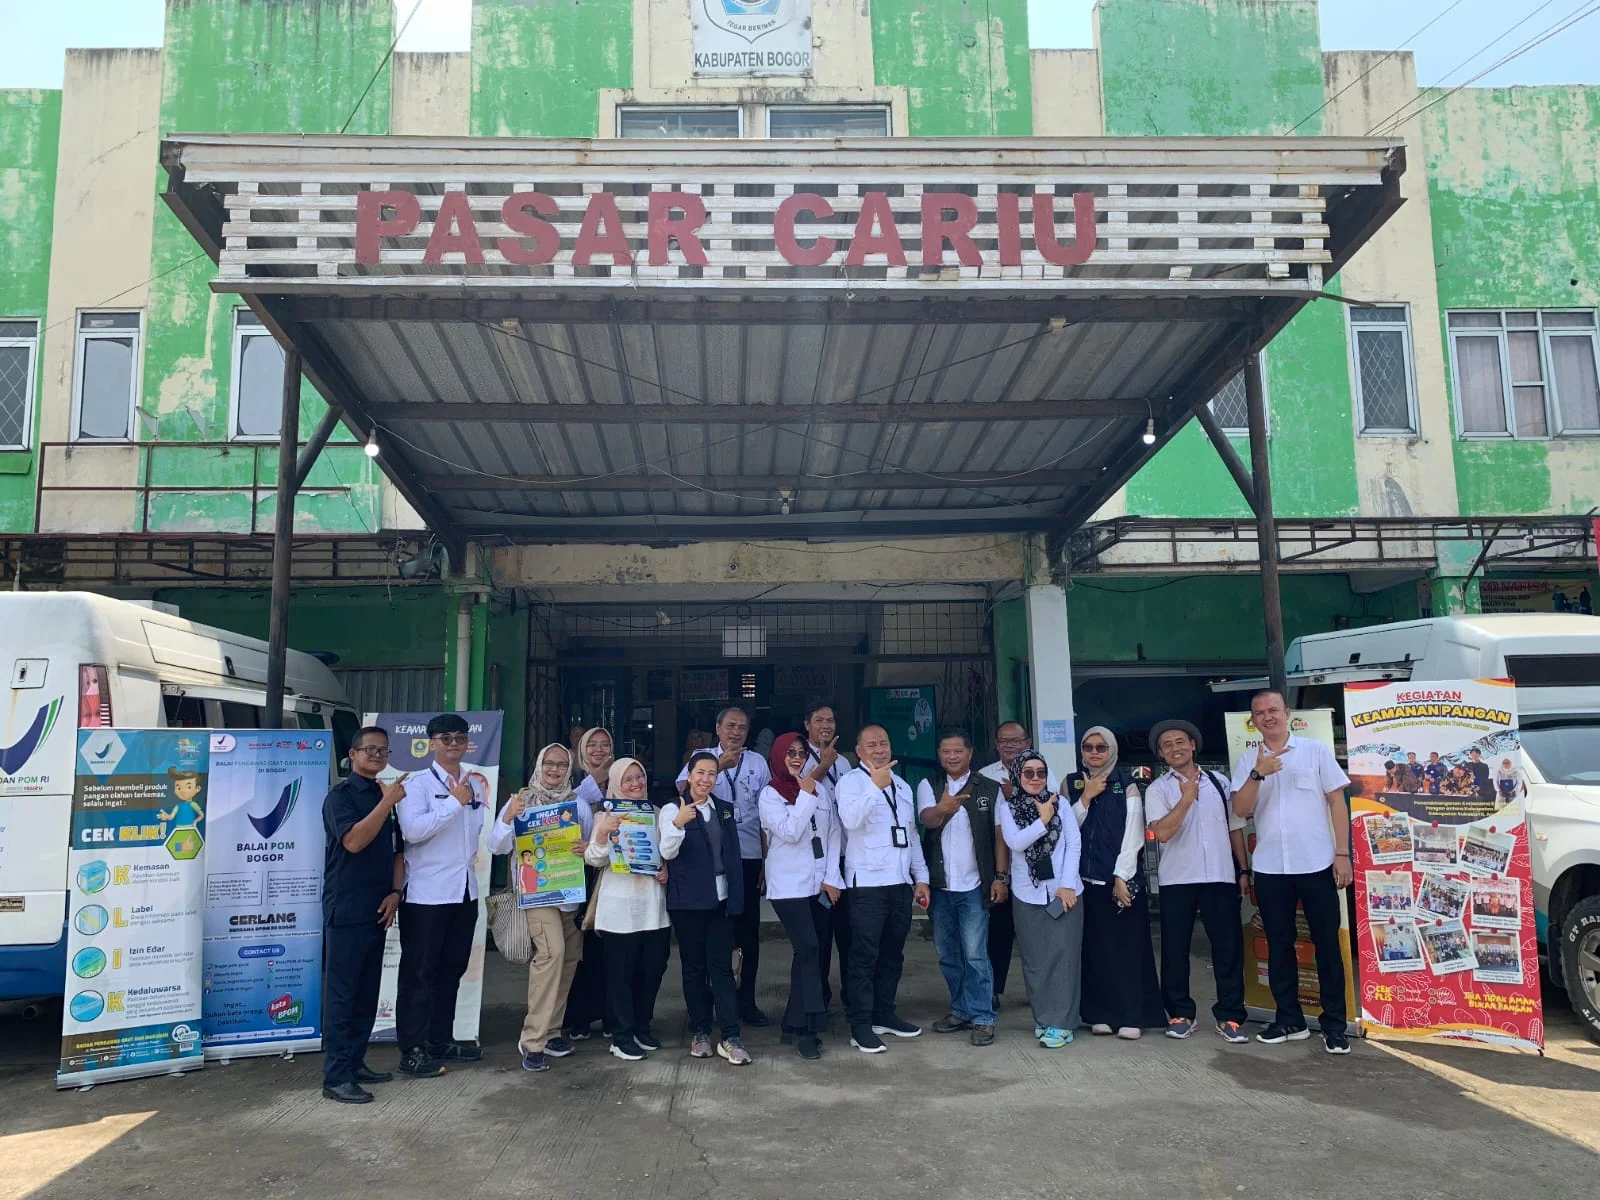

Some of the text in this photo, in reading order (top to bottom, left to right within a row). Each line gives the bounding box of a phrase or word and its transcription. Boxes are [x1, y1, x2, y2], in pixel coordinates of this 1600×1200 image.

[694, 51, 810, 68] KABUPATEN BOGOR
[354, 190, 1098, 266] PASAR CARIU
[1396, 690, 1463, 703] KEGIATAN
[1351, 703, 1512, 728] KEAMANAN PANGAN
[18, 776, 38, 784] POM
[40, 775, 50, 783] RI
[144, 783, 168, 792] produk
[83, 791, 167, 801] pangan olahan terkemas,
[83, 799, 104, 807] selalu
[105, 799, 123, 808] ingat
[535, 808, 560, 819] INGAT
[527, 820, 541, 828] CEK
[81, 822, 167, 843] CEK KLIK!
[236, 841, 295, 852] BALAI POM
[246, 853, 285, 863] BOGOR
[133, 863, 170, 872] Kemasan
[113, 865, 132, 886] K
[131, 905, 153, 914] Label
[113, 907, 129, 928] L
[229, 912, 297, 926] CERLANG
[1568, 924, 1580, 943] GT
[129, 945, 166, 955] Izin Edar
[243, 947, 280, 956] CONTACT US
[127, 984, 182, 996] Kedaluwarsa
[107, 991, 125, 1013] K
[1483, 993, 1507, 1003] TIDAK
[1508, 996, 1536, 1007] AMAN
[278, 1006, 299, 1019] BPOM
